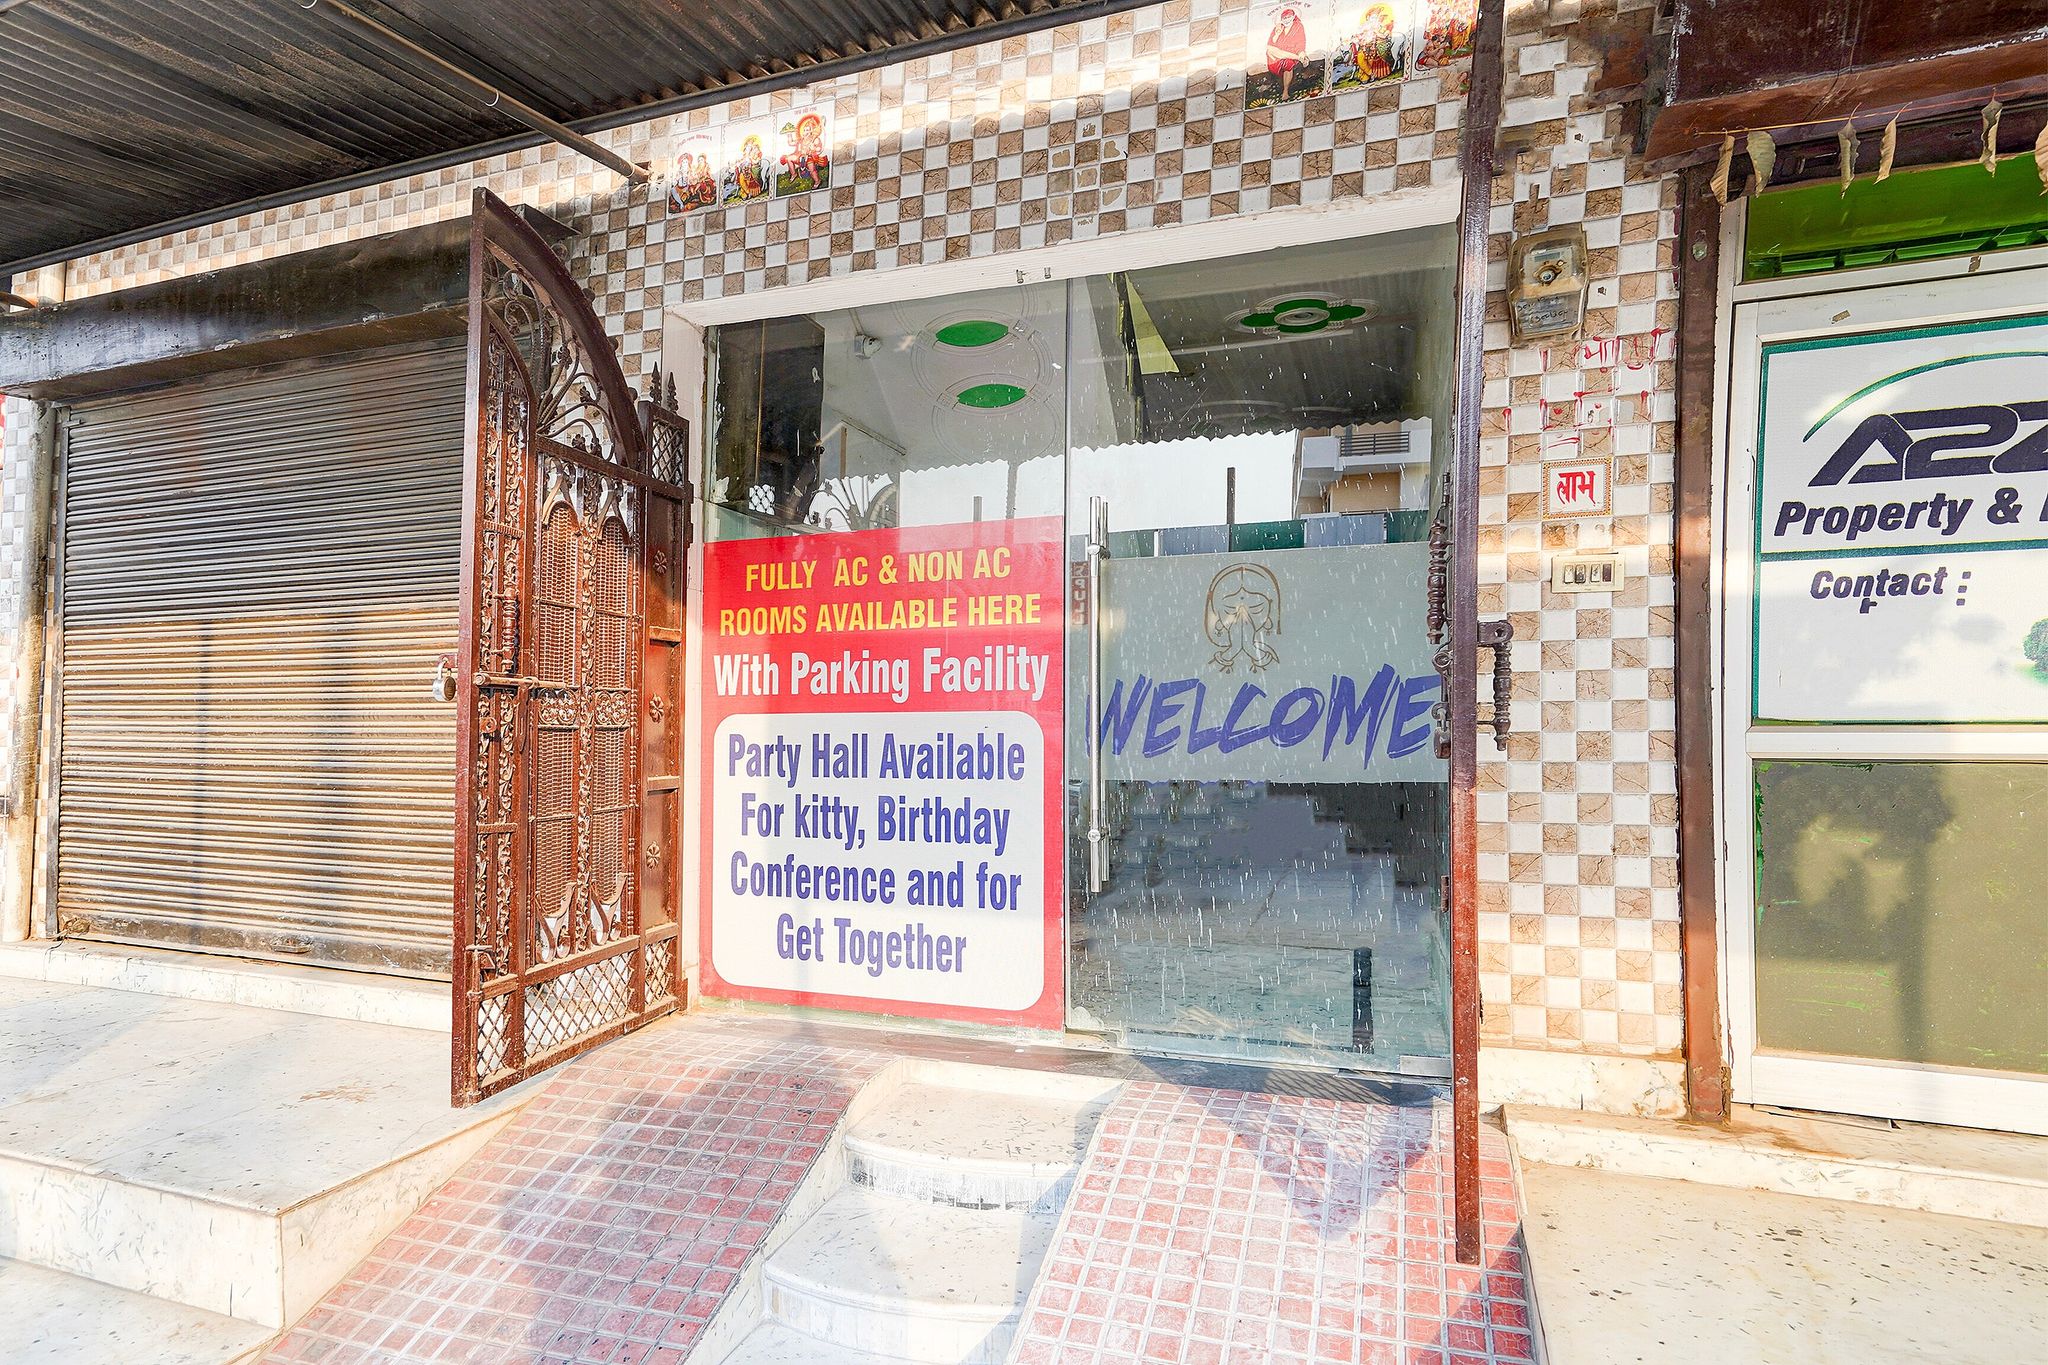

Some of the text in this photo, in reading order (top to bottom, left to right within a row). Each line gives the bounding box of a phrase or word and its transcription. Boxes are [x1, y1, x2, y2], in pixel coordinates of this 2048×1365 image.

[1557, 469, 1595, 506] लाभ
[1774, 492, 1974, 541] Property
[1987, 486, 2023, 525] &
[745, 547, 1011, 591] FULLY AC & NON AC
[1810, 567, 1948, 600] Contact
[719, 593, 1041, 636] ROOMS AVAILABLE HERE
[713, 645, 1050, 703] With Parking Facility
[1085, 664, 1442, 770] WELCOME
[728, 732, 1025, 788] Party Hall Available
[741, 793, 1010, 856] For kitty, Birthday
[730, 851, 1022, 910] Conference and for
[776, 913, 967, 977] Get Together
